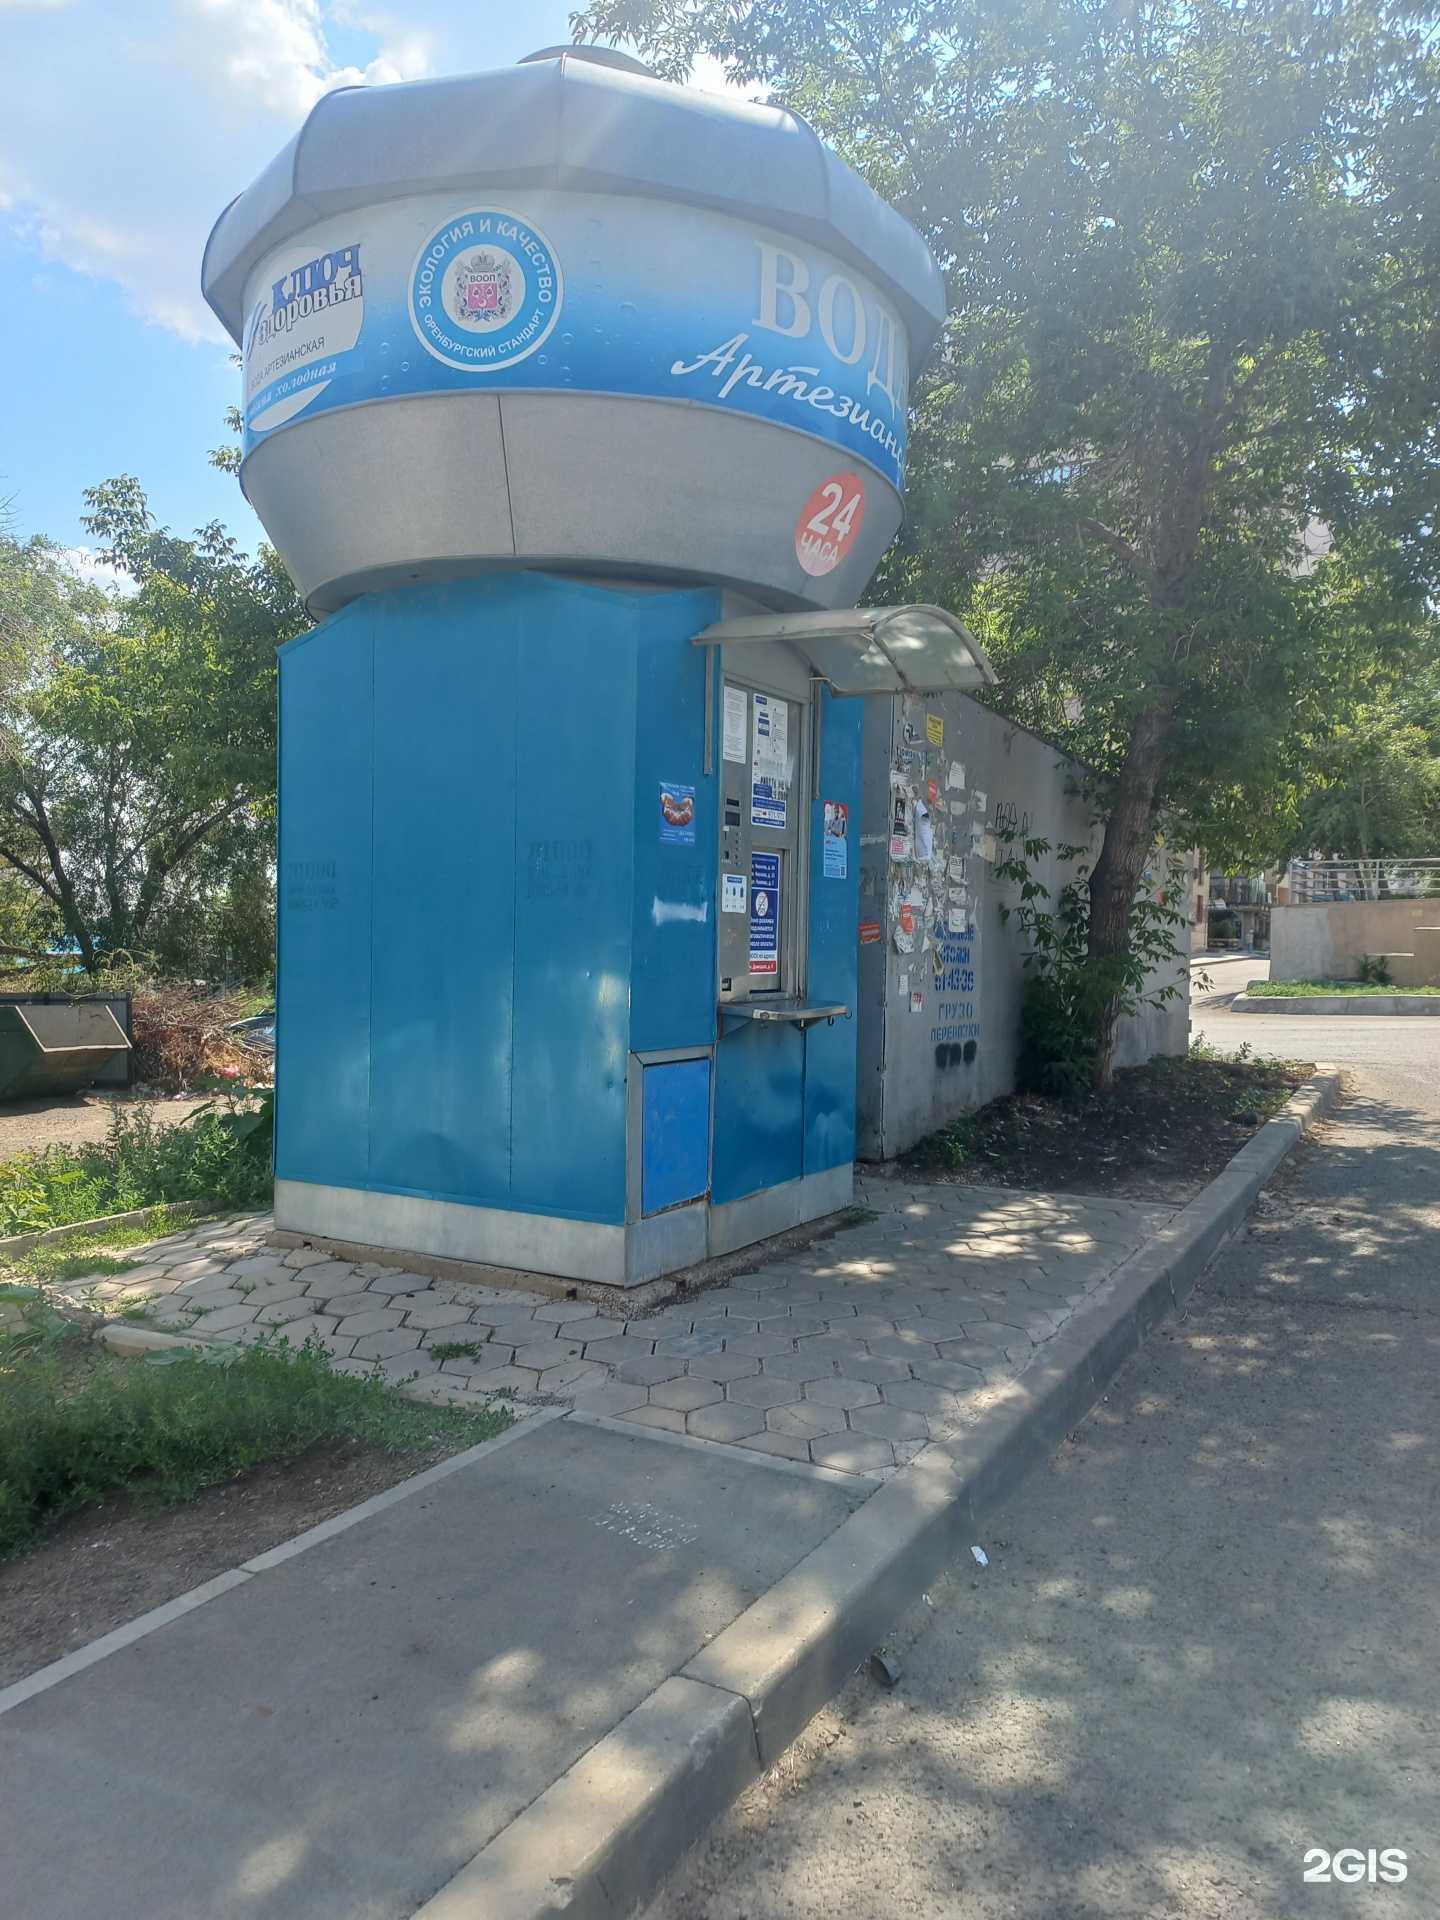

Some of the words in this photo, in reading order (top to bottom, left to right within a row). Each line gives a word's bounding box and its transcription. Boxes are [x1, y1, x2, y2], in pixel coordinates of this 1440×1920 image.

[419, 221, 474, 309] ЭКОЛОГИЯ
[479, 218, 491, 233] И
[496, 221, 552, 303] КАЧЕСТВО
[470, 273, 496, 283] ВООП
[424, 313, 496, 358] ОРЕНБУРГСКИЙ
[498, 308, 545, 354] СТАНДАРТ
[264, 336, 325, 377] АРТЕЗИАНСКАЯ
[806, 482, 862, 542] 24
[801, 531, 839, 564] ЧАСА
